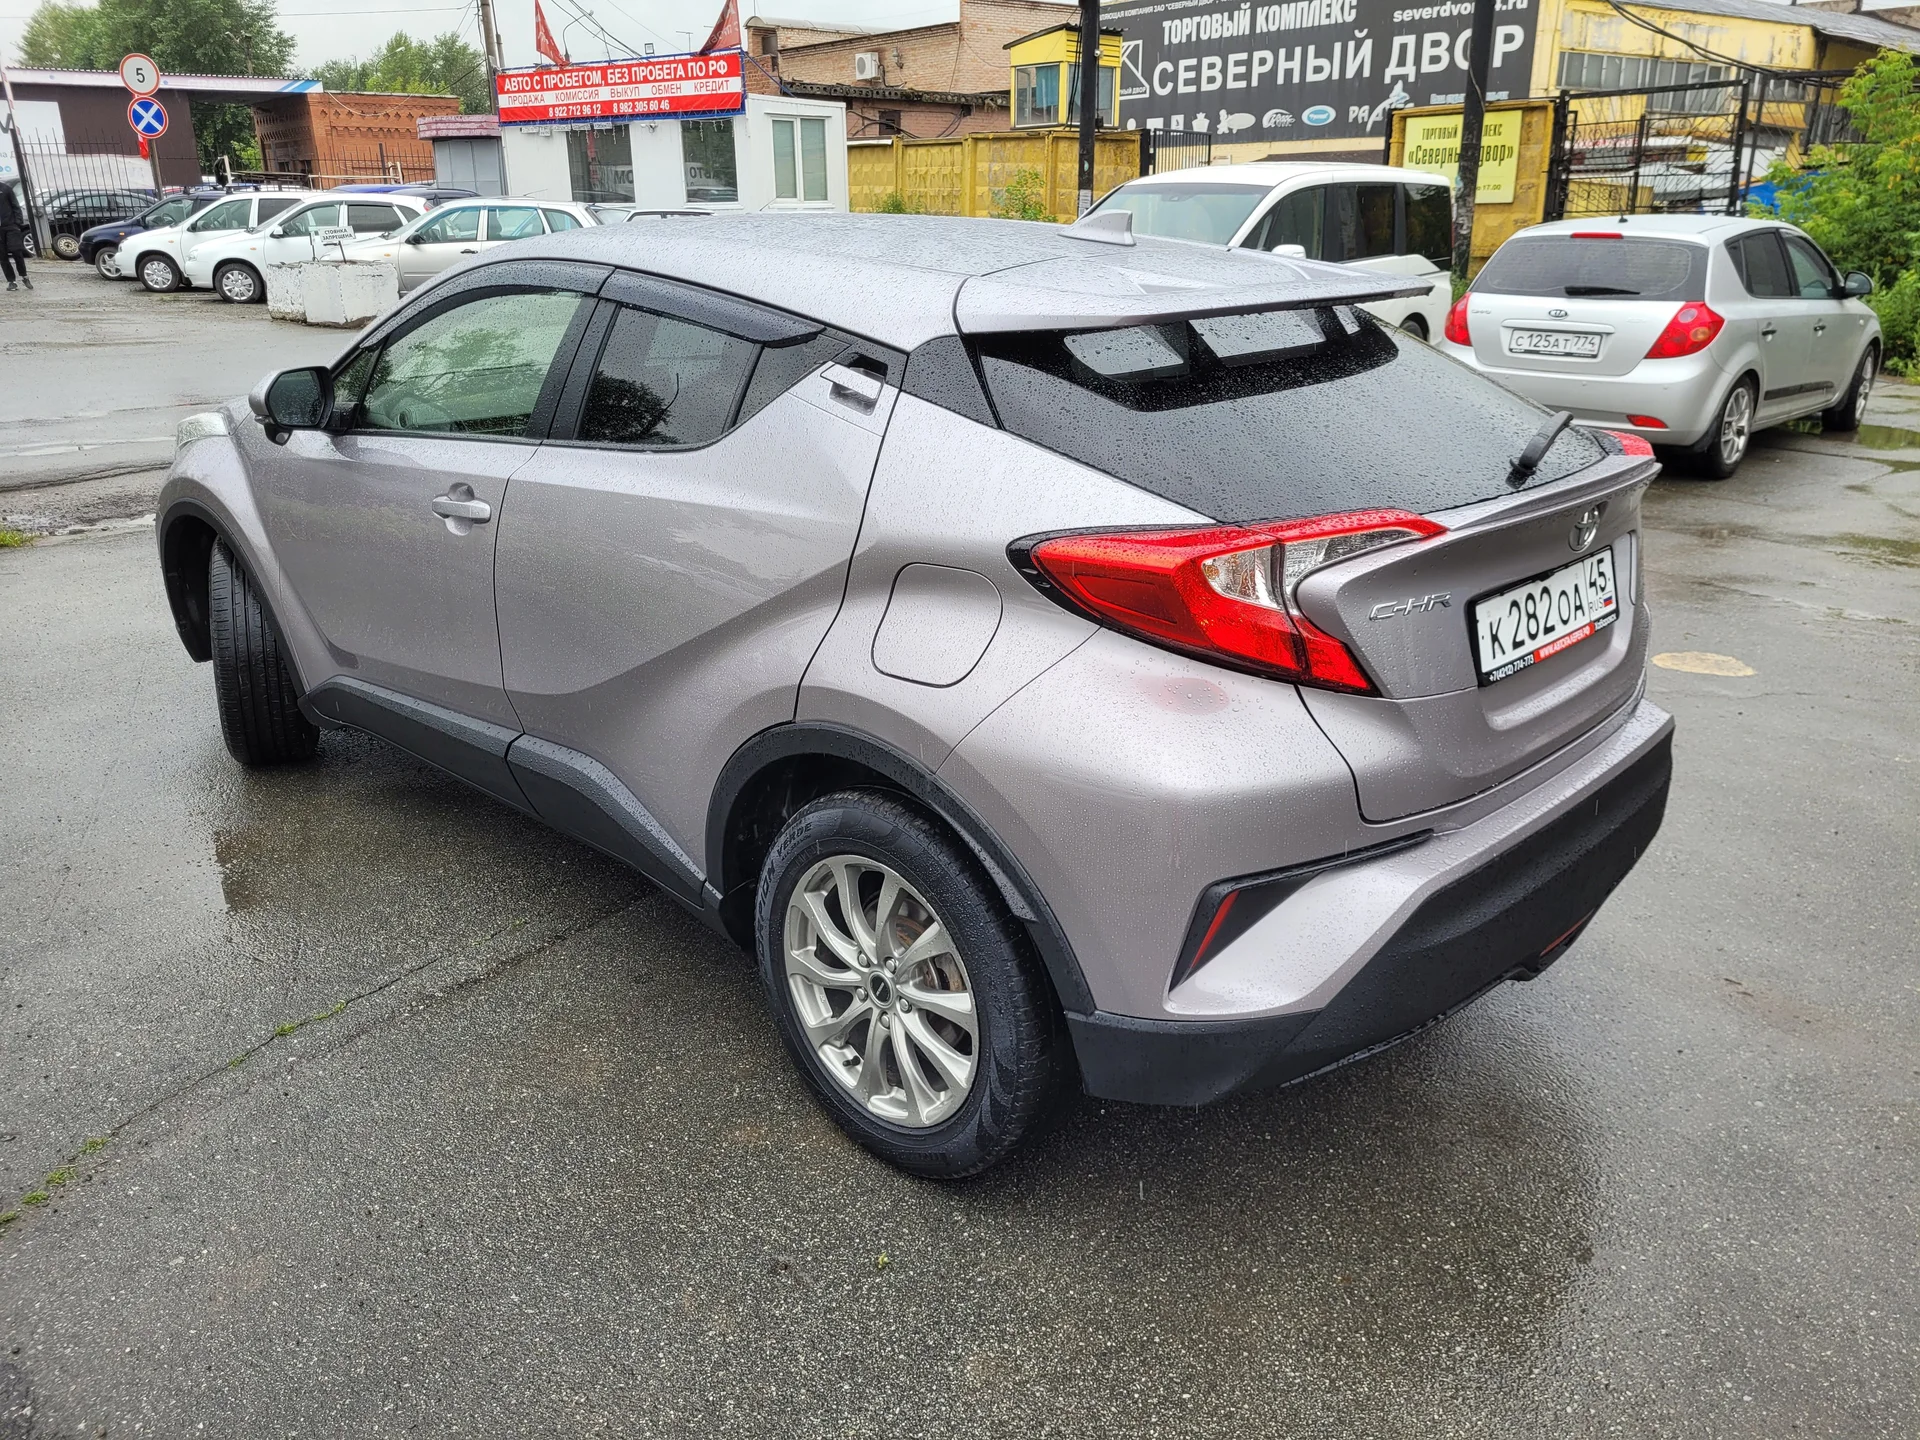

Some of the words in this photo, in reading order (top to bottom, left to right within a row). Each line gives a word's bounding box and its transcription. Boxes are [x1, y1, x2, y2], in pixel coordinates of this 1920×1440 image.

[1163, 2, 1251, 46] ТОРГОВЫЙ
[1255, 0, 1358, 34] КОМПЛЕКС
[1153, 28, 1373, 96] СЕВЕРНЫЙ
[1384, 25, 1525, 84] ДВОР
[135, 67, 146, 83] 5
[504, 77, 531, 92] АВТО
[533, 76, 541, 90] С
[543, 70, 605, 89] ПРОБЕГОМ,
[607, 68, 629, 84] БЕЗ
[631, 62, 686, 82] ПРОБЕГА
[688, 61, 706, 77] ПО
[708, 60, 728, 76] РФ
[508, 93, 545, 106] ПРОДАЖА
[555, 89, 600, 102] КОМИССИЯ
[611, 86, 640, 98] ВЫКУП
[651, 84, 682, 95] ОБМЕН
[694, 80, 730, 94] КРЕДИТ
[548, 107, 554, 117] 8
[554, 106, 567, 117] 922
[568, 105, 581, 116] 712
[582, 104, 591, 115] 96
[593, 103, 602, 114] 12
[613, 103, 618, 113] 8
[619, 102, 633, 113] 982
[634, 101, 648, 112] 305
[649, 100, 659, 111] 60
[660, 99, 670, 110] 46
[1422, 124, 1458, 140] ТОРГОВЫЙ
[322, 233, 353, 241] ЗАПРЕЩЕНА
[1490, 583, 1585, 660] К282ОА
[1589, 557, 1607, 596] 45
[1589, 597, 1604, 612] RUS
[776, 821, 812, 856] VERDE
